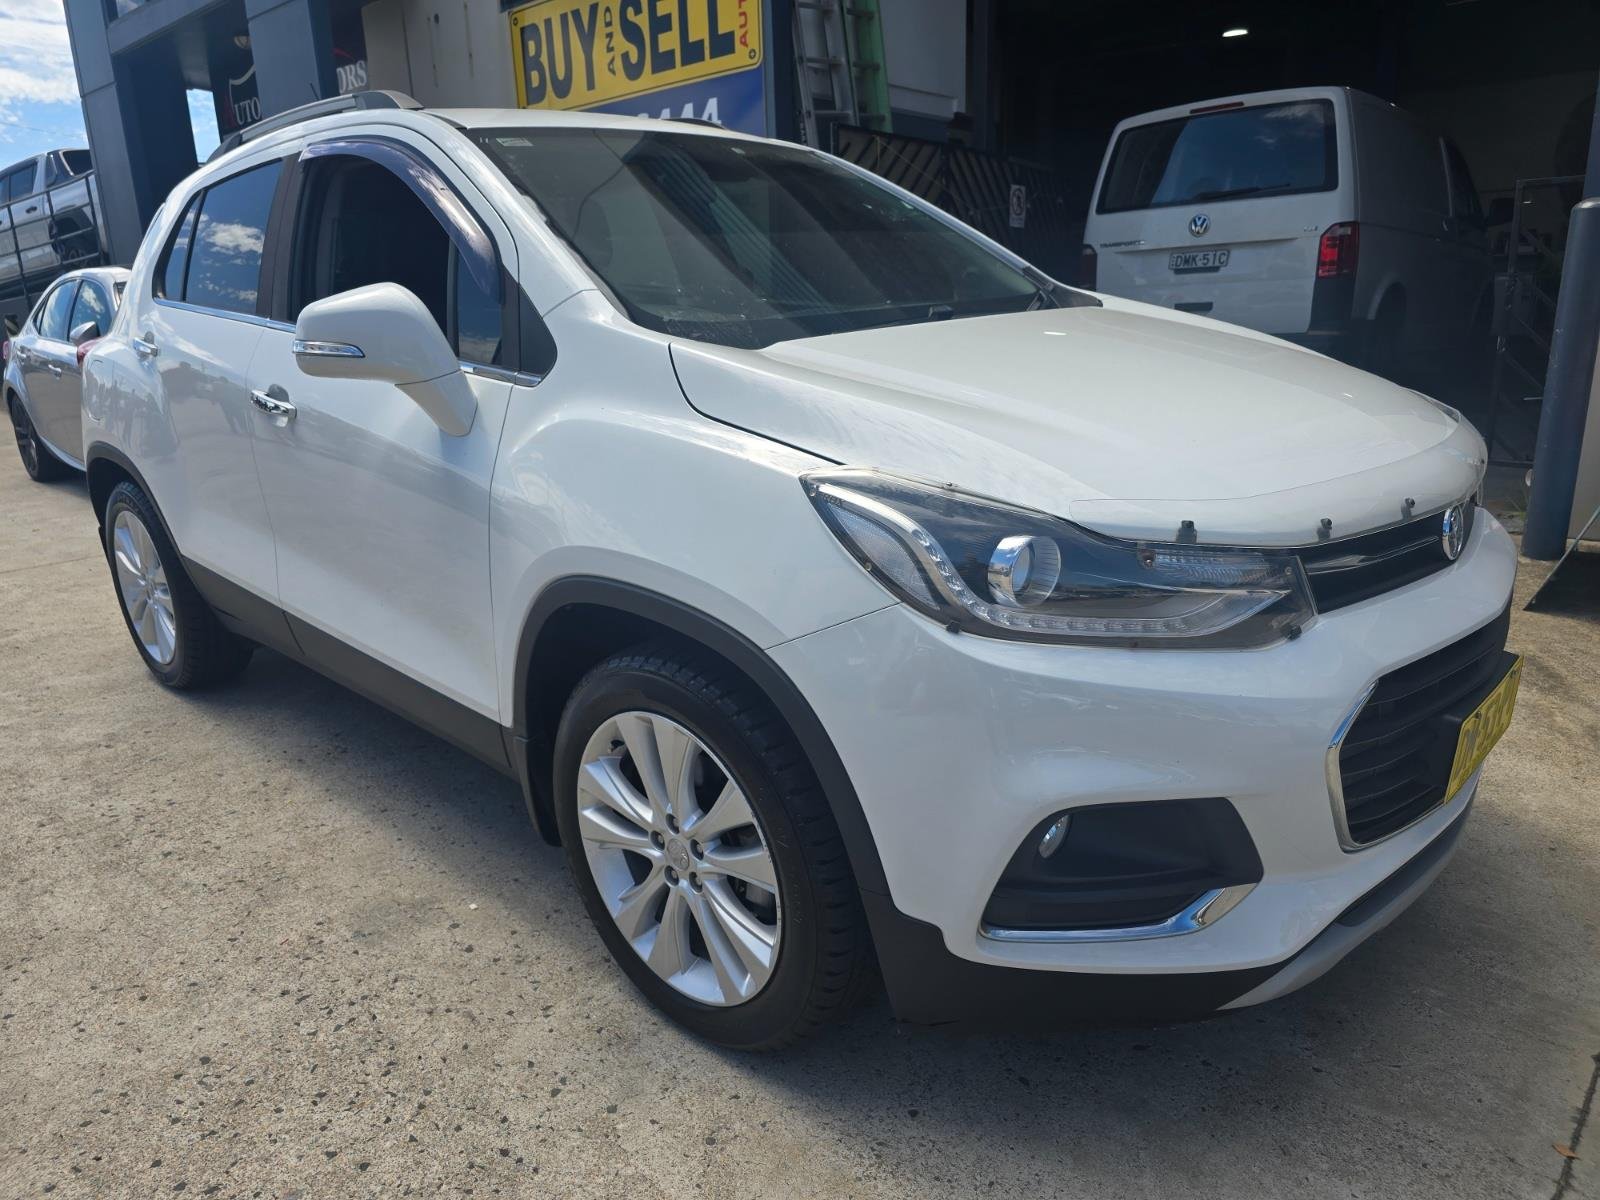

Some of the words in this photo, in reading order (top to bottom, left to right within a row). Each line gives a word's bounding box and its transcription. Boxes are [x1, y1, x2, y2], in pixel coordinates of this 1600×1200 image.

[520, 3, 599, 106] BUY
[603, 6, 617, 76] AND
[619, 0, 736, 81] SELL
